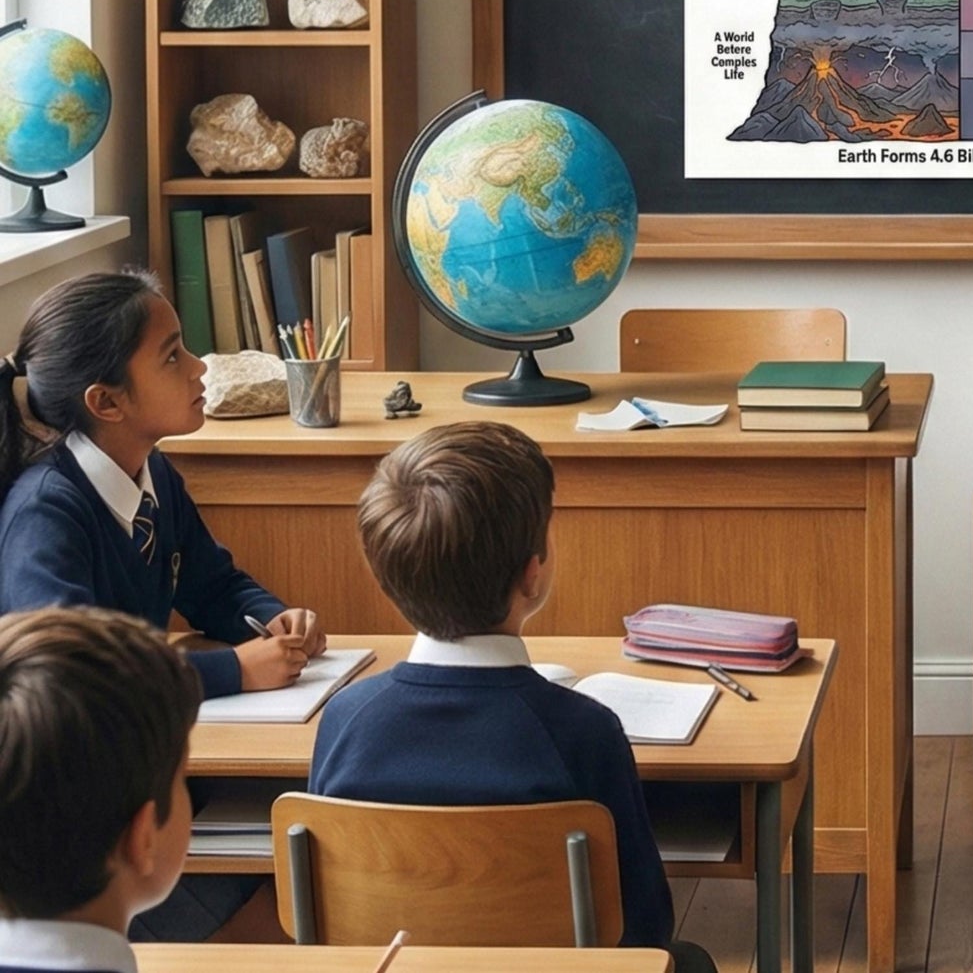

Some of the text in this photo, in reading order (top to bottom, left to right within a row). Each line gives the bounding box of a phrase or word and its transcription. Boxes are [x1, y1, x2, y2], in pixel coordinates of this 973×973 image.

[714, 31, 721, 42] A
[838, 148, 877, 164] Earth
[881, 149, 927, 164] Forms
[930, 149, 954, 164] 4.6
